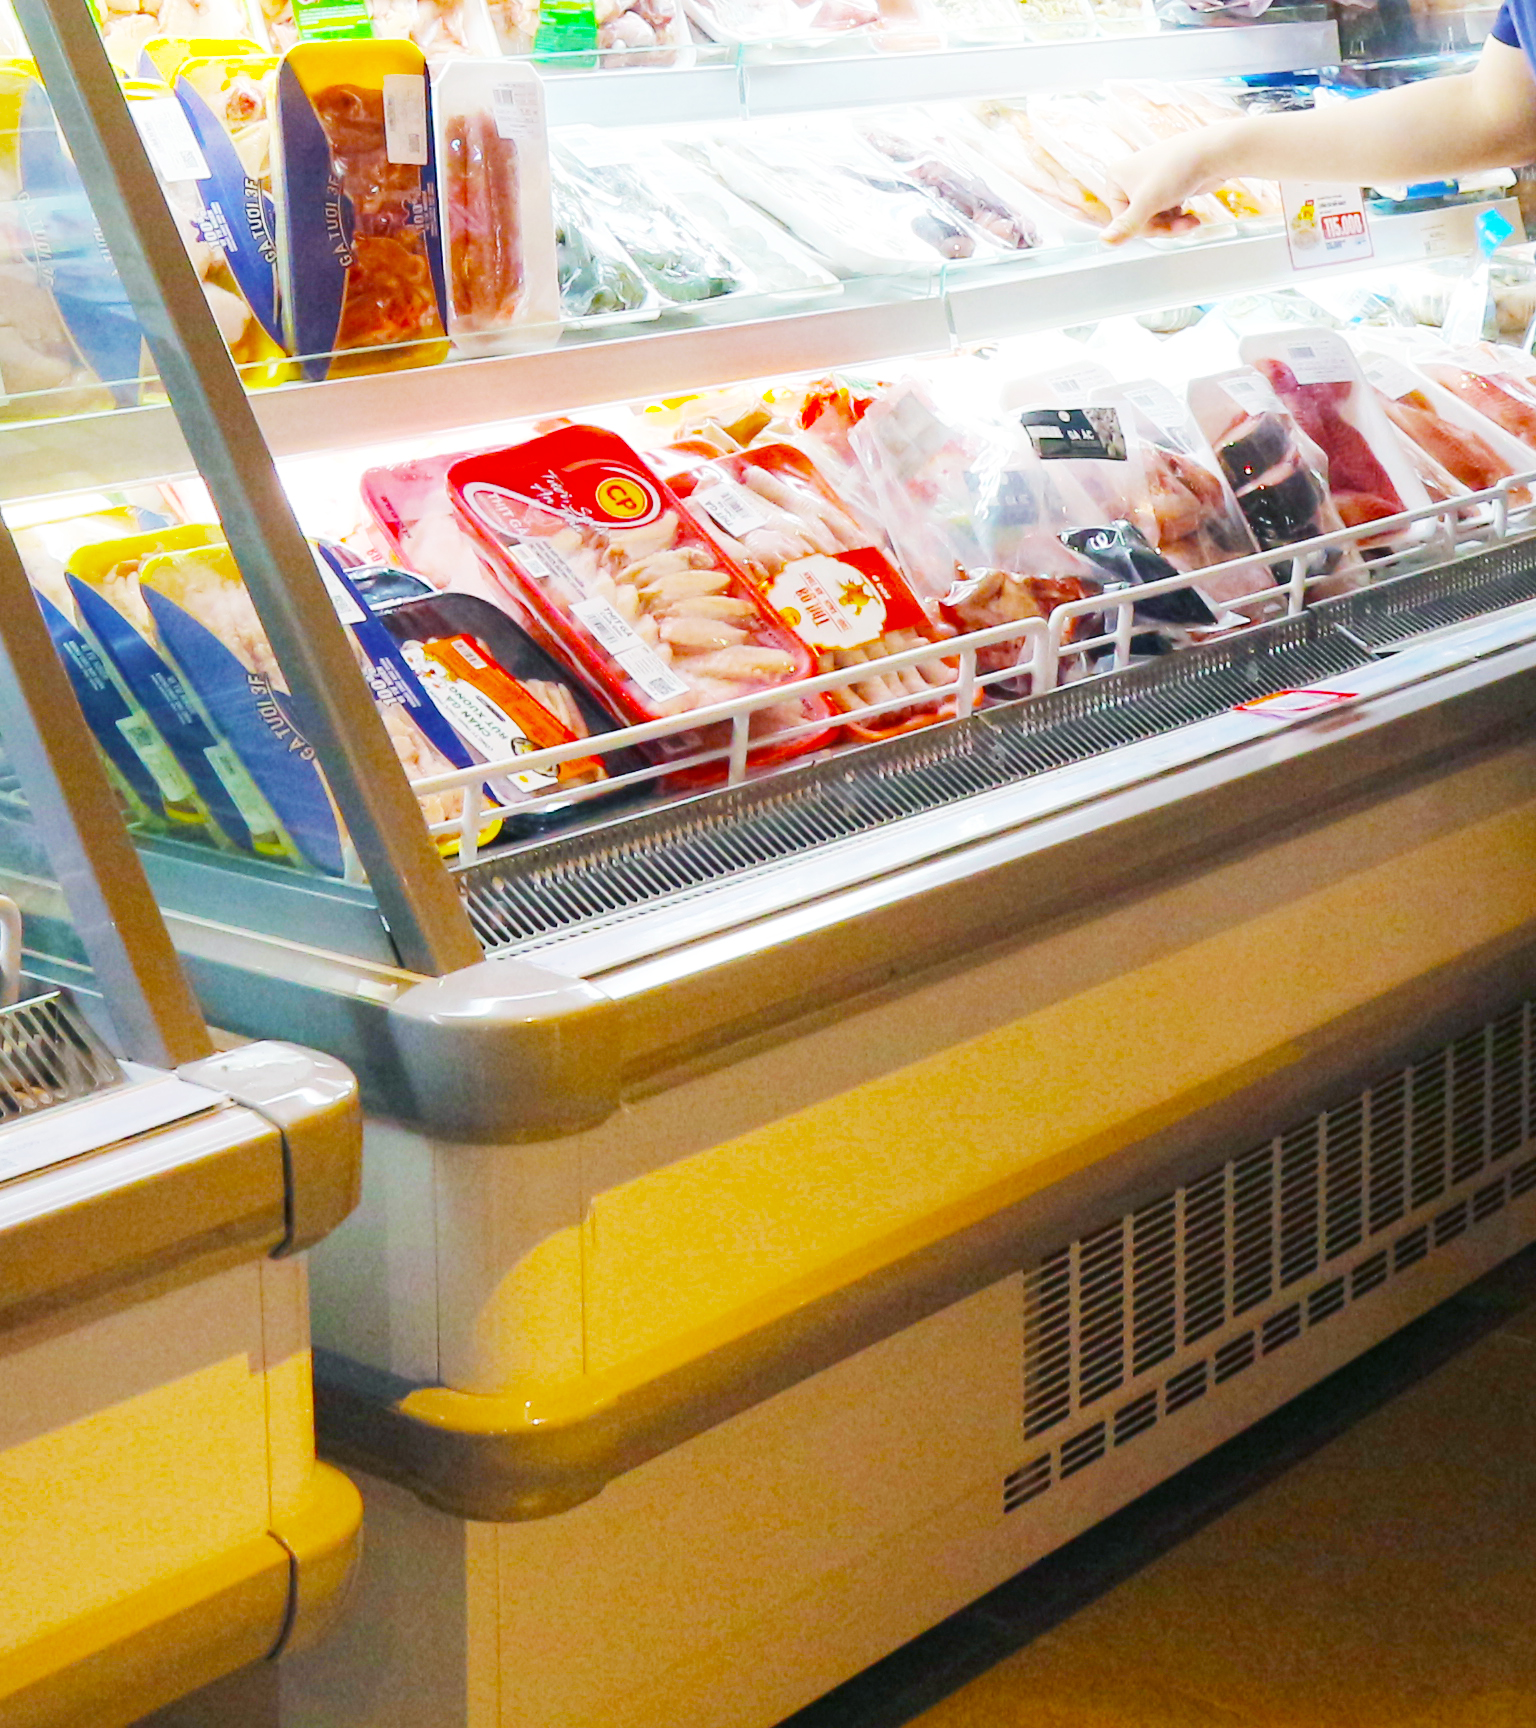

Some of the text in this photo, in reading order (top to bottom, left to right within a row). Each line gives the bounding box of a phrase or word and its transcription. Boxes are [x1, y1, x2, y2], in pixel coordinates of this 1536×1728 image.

[244, 178, 259, 198] 3F
[327, 175, 341, 196] 3F
[1323, 213, 1363, 239] 115.000
[606, 484, 637, 514] CP
[248, 673, 269, 696] 3F
